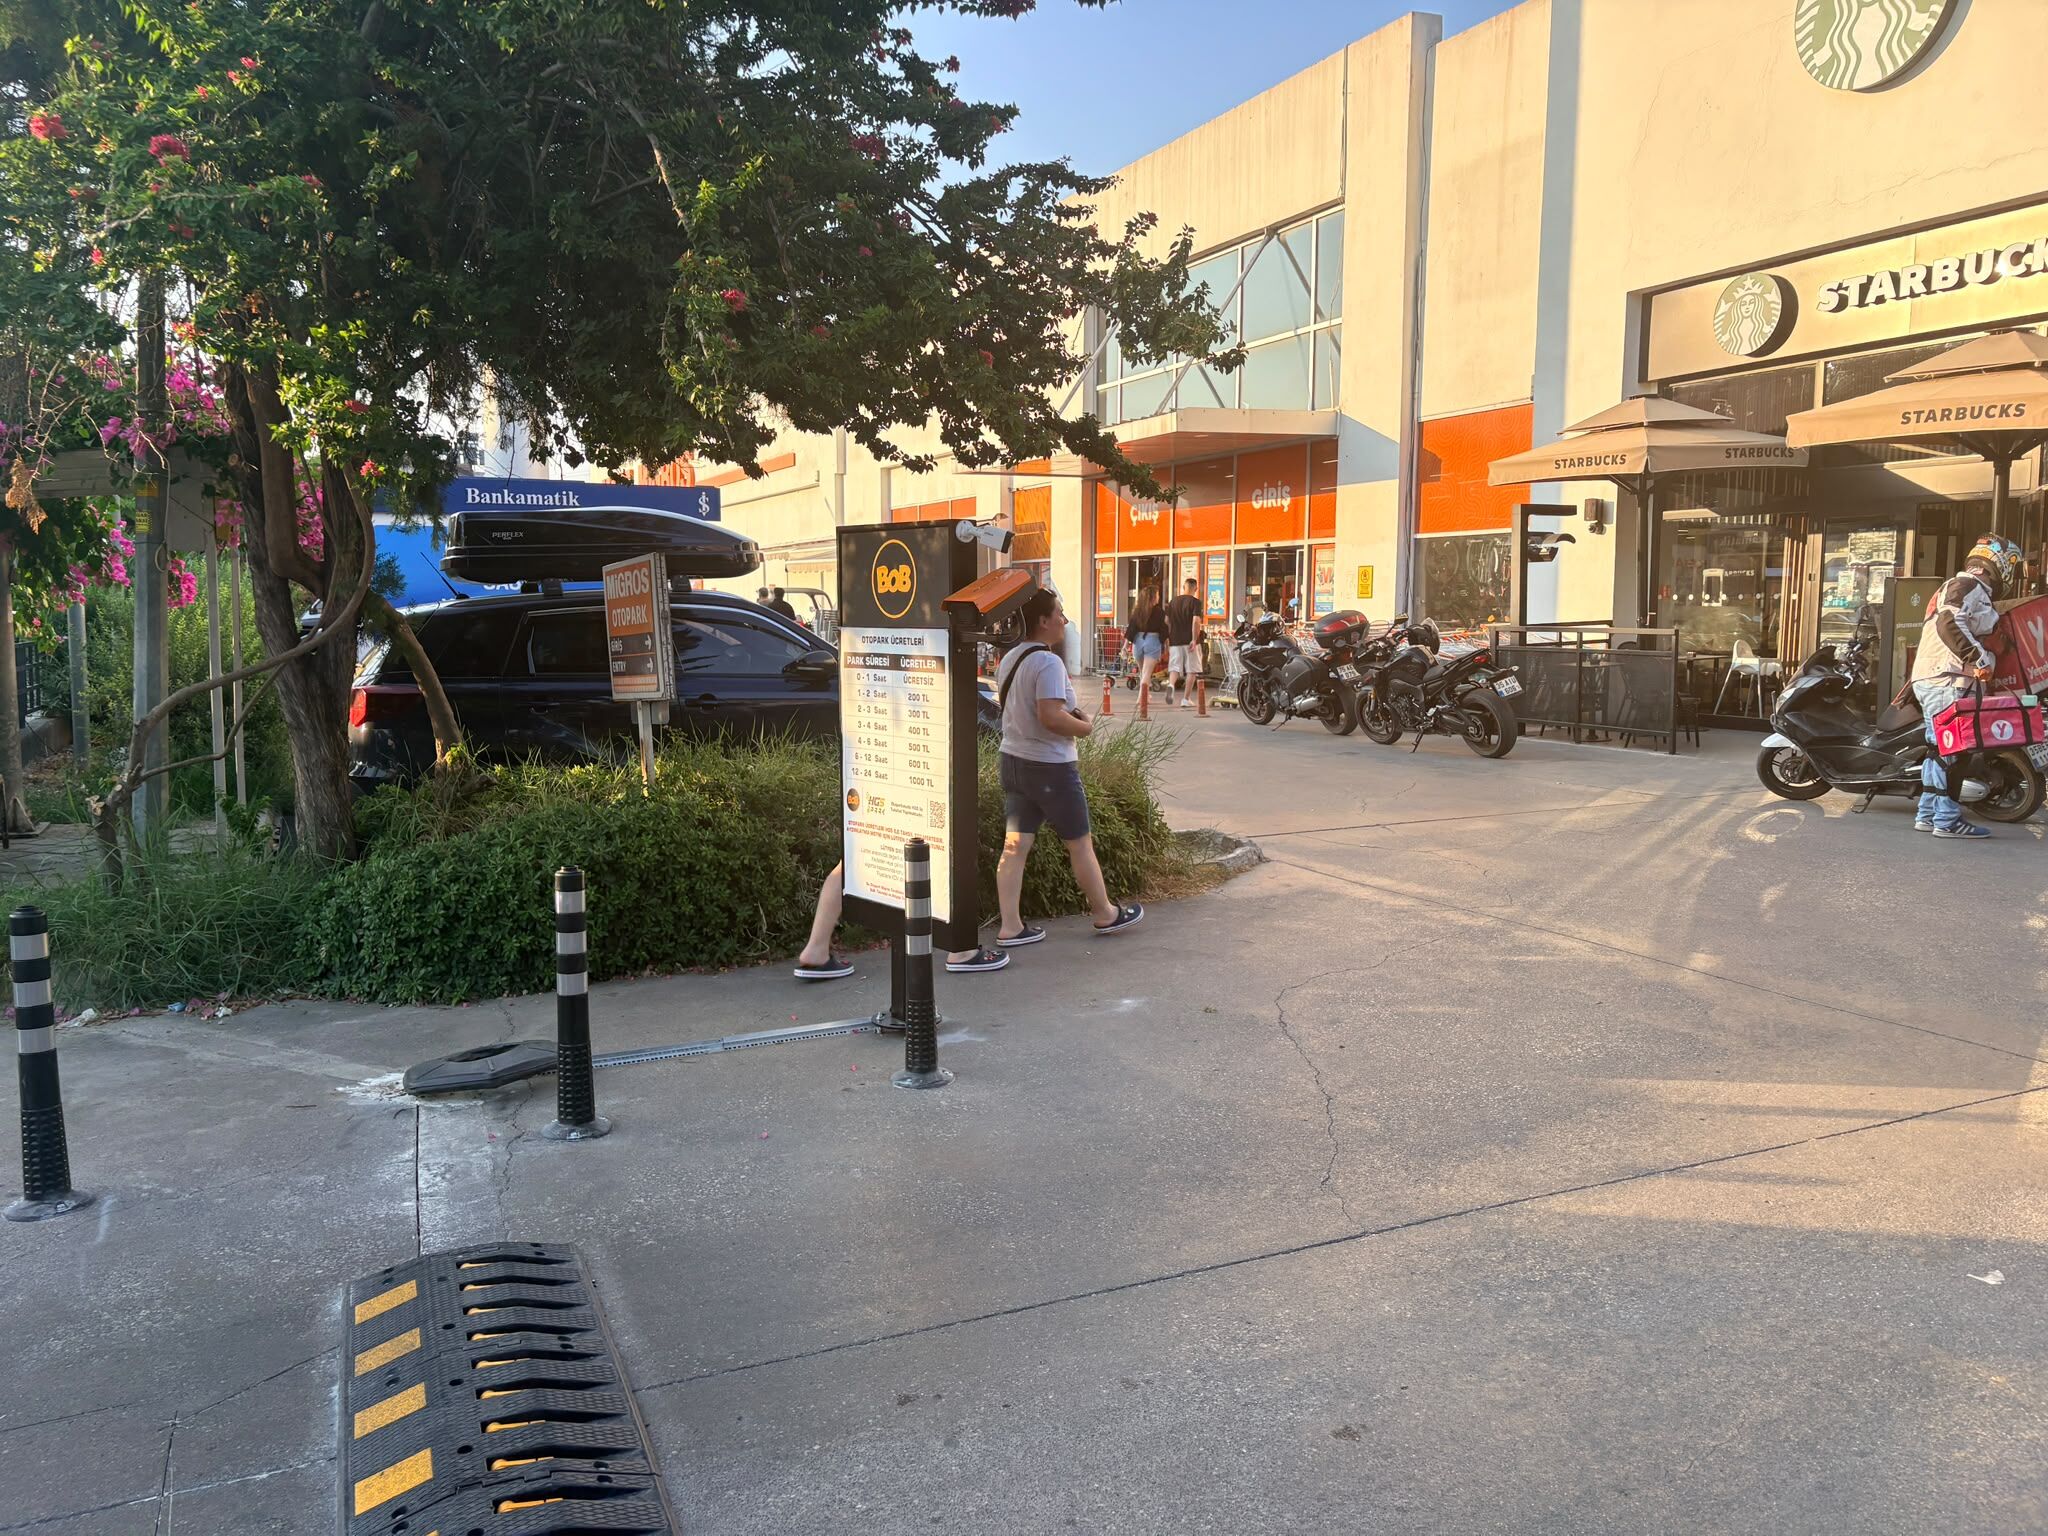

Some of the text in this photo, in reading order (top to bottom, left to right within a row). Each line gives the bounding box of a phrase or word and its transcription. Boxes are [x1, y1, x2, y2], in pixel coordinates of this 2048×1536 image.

[1900, 403, 2026, 425] STARBUCKS
[1724, 447, 1795, 459] STARBUCKS
[1554, 454, 1627, 470] STARBUCKS
[465, 487, 580, 506] Bankamatik
[1251, 481, 1291, 512] GİRİŞ
[1129, 502, 1159, 527] ÇIKIŞ
[612, 603, 648, 628] OTOPARK
[861, 635, 925, 646] OTOPARK ÜCRETLERİ
[846, 654, 890, 667] PARK SÜRESİ
[900, 656, 937, 669] ÜCRETLER
[612, 660, 626, 673] ENTRY
[873, 673, 887, 683] Saat
[873, 690, 887, 699] Saat
[908, 692, 930, 702] 200 TL
[874, 706, 888, 715] Saat
[908, 709, 930, 719] 300 TL
[874, 722, 888, 731] Saat
[908, 726, 930, 736] 400 TL
[874, 738, 888, 748] Saat
[908, 742, 930, 753] 500 TL
[874, 754, 888, 764] Saat
[908, 759, 930, 770] 600 TL
[874, 770, 889, 780] Saat
[926, 778, 934, 788] TL
[867, 795, 886, 807] HGS
